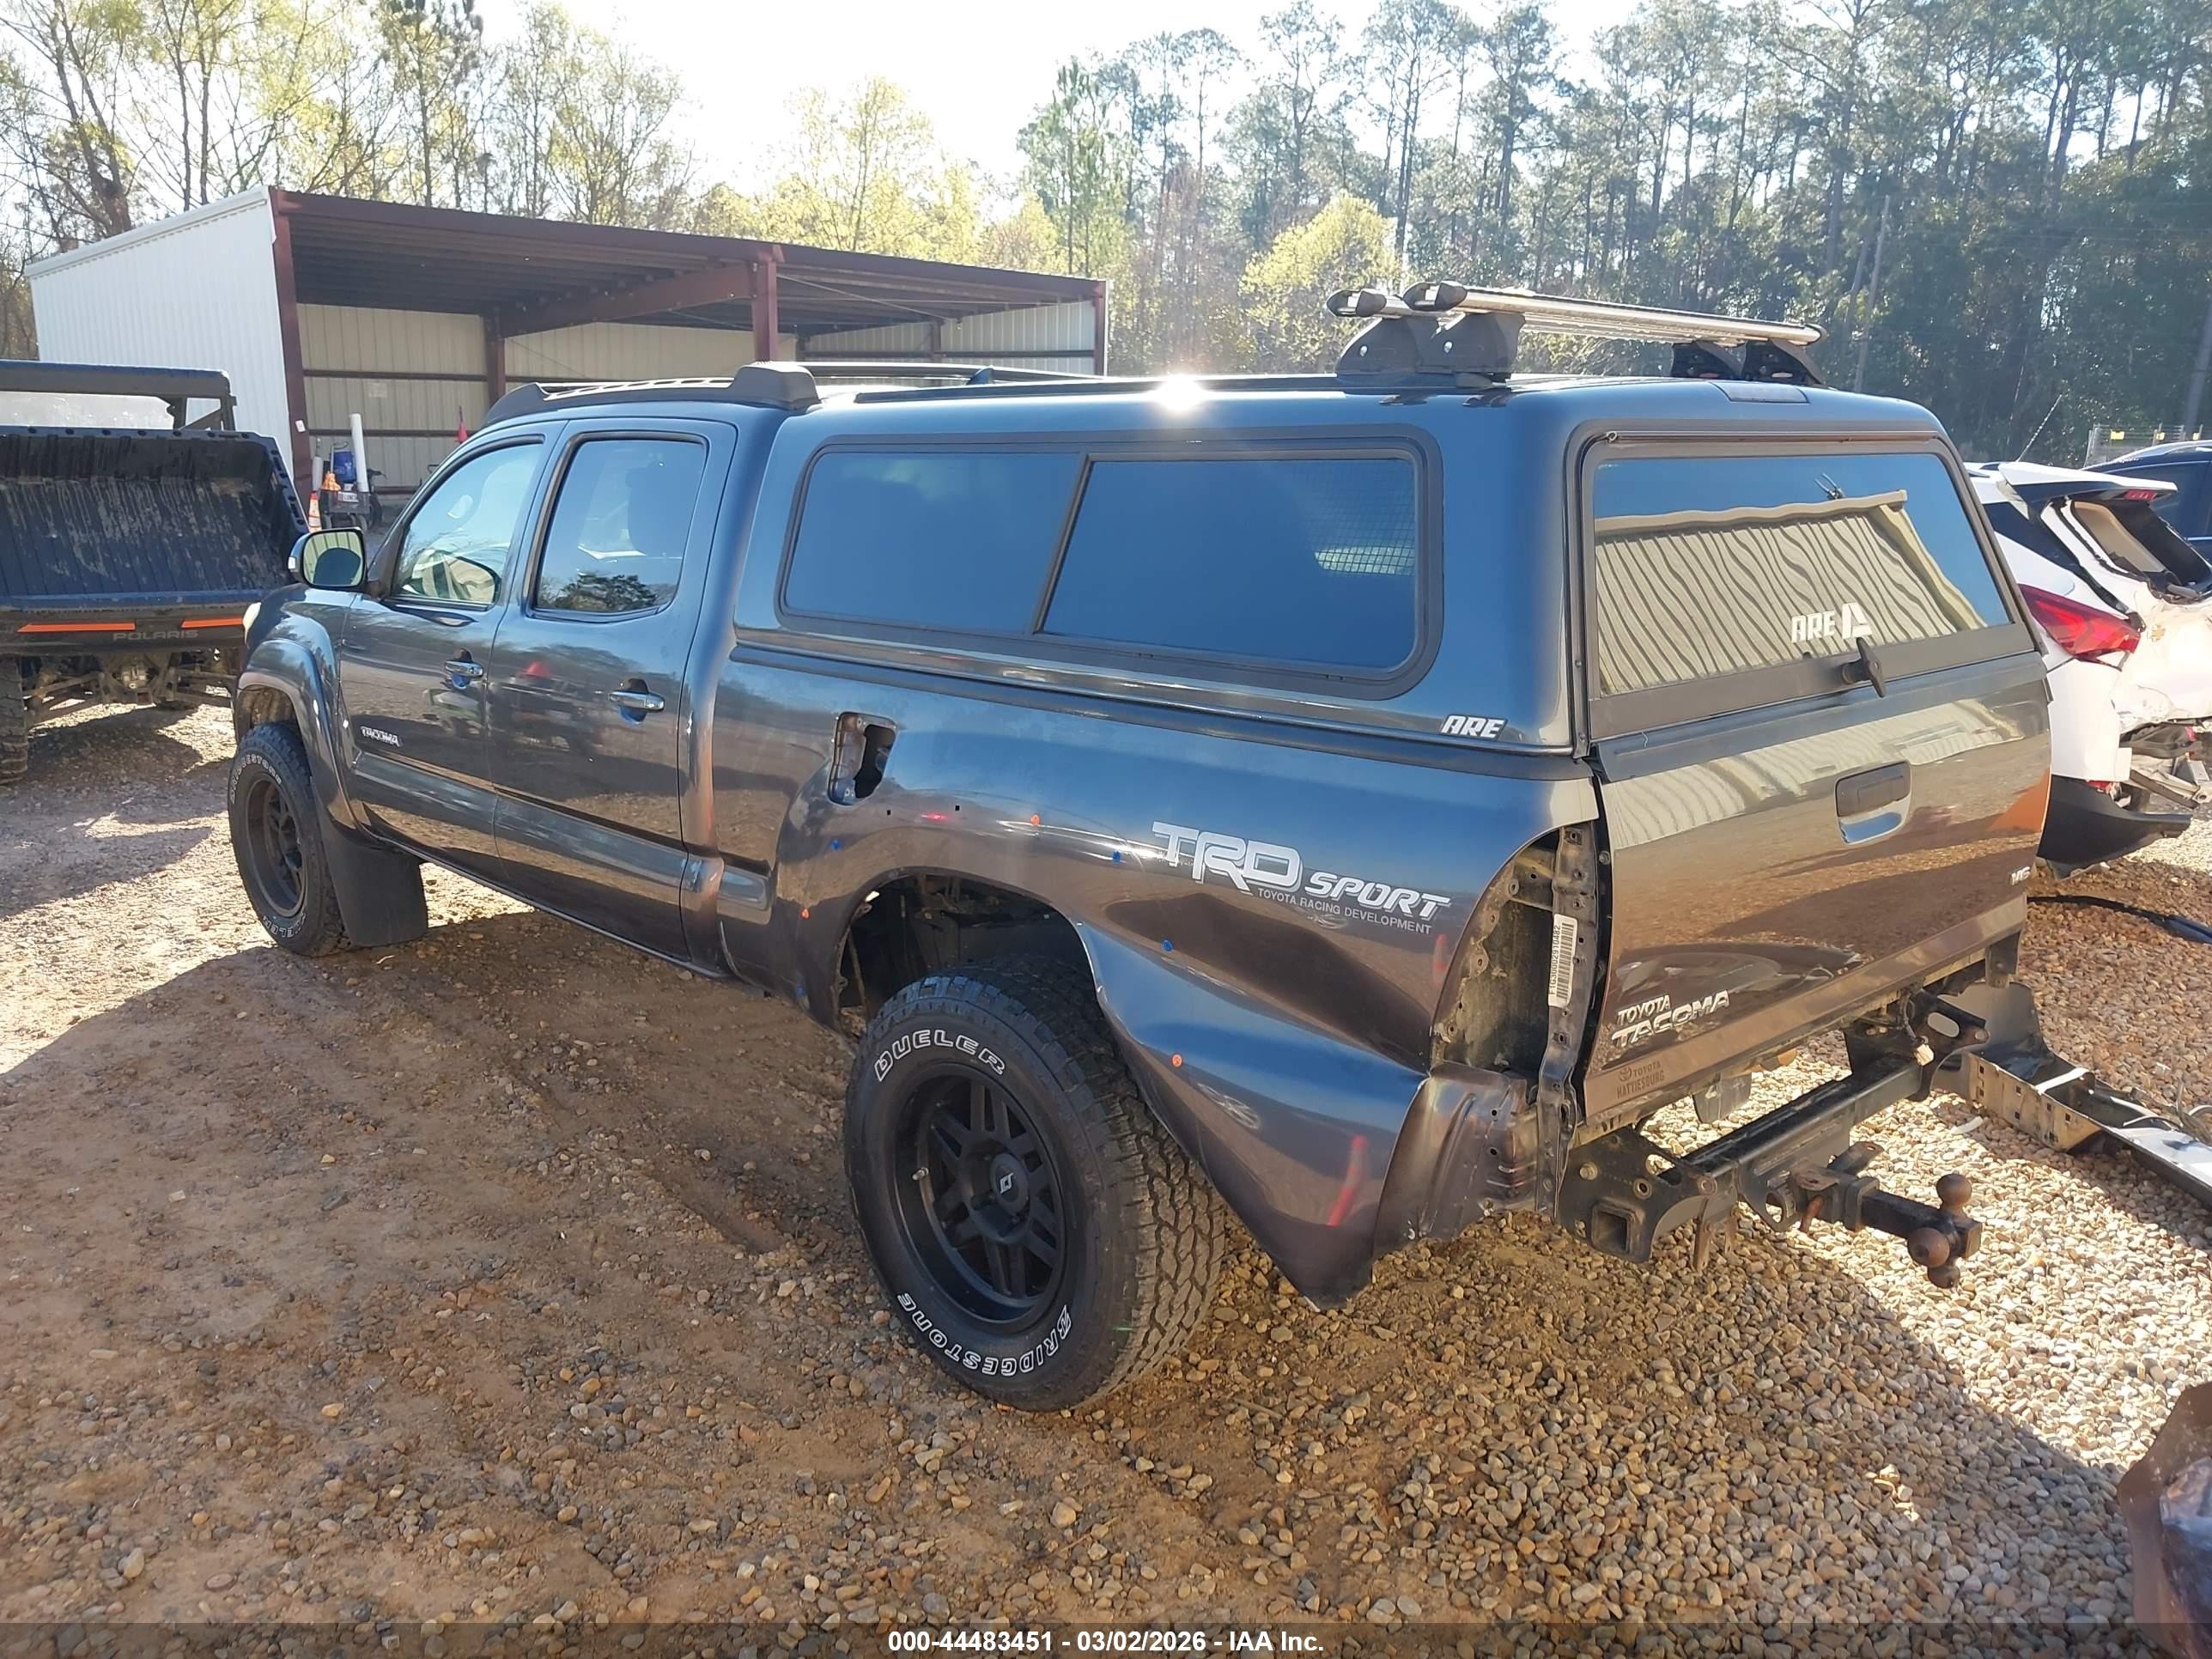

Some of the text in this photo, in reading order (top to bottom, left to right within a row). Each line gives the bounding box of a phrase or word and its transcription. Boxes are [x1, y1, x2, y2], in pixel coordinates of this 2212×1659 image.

[112, 629, 198, 641] POLARIS
[1790, 609, 1836, 644] ARE
[360, 726, 401, 747] TACOMA
[1441, 714, 1505, 738] ARE
[1152, 821, 1450, 921] TRD SPORT
[2011, 866, 2031, 885] V6
[1257, 887, 1432, 935] TOYOTA RACING DEVELOPMENT
[1611, 989, 1730, 1048] TACOMA
[1617, 994, 1671, 1026] TOYOTA
[874, 1030, 1006, 1082] DUELER
[1633, 1060, 1662, 1078] TOYOTA
[1616, 1070, 1665, 1099] HATTIESBURG
[896, 1292, 1072, 1376] BRIDGESTONE
